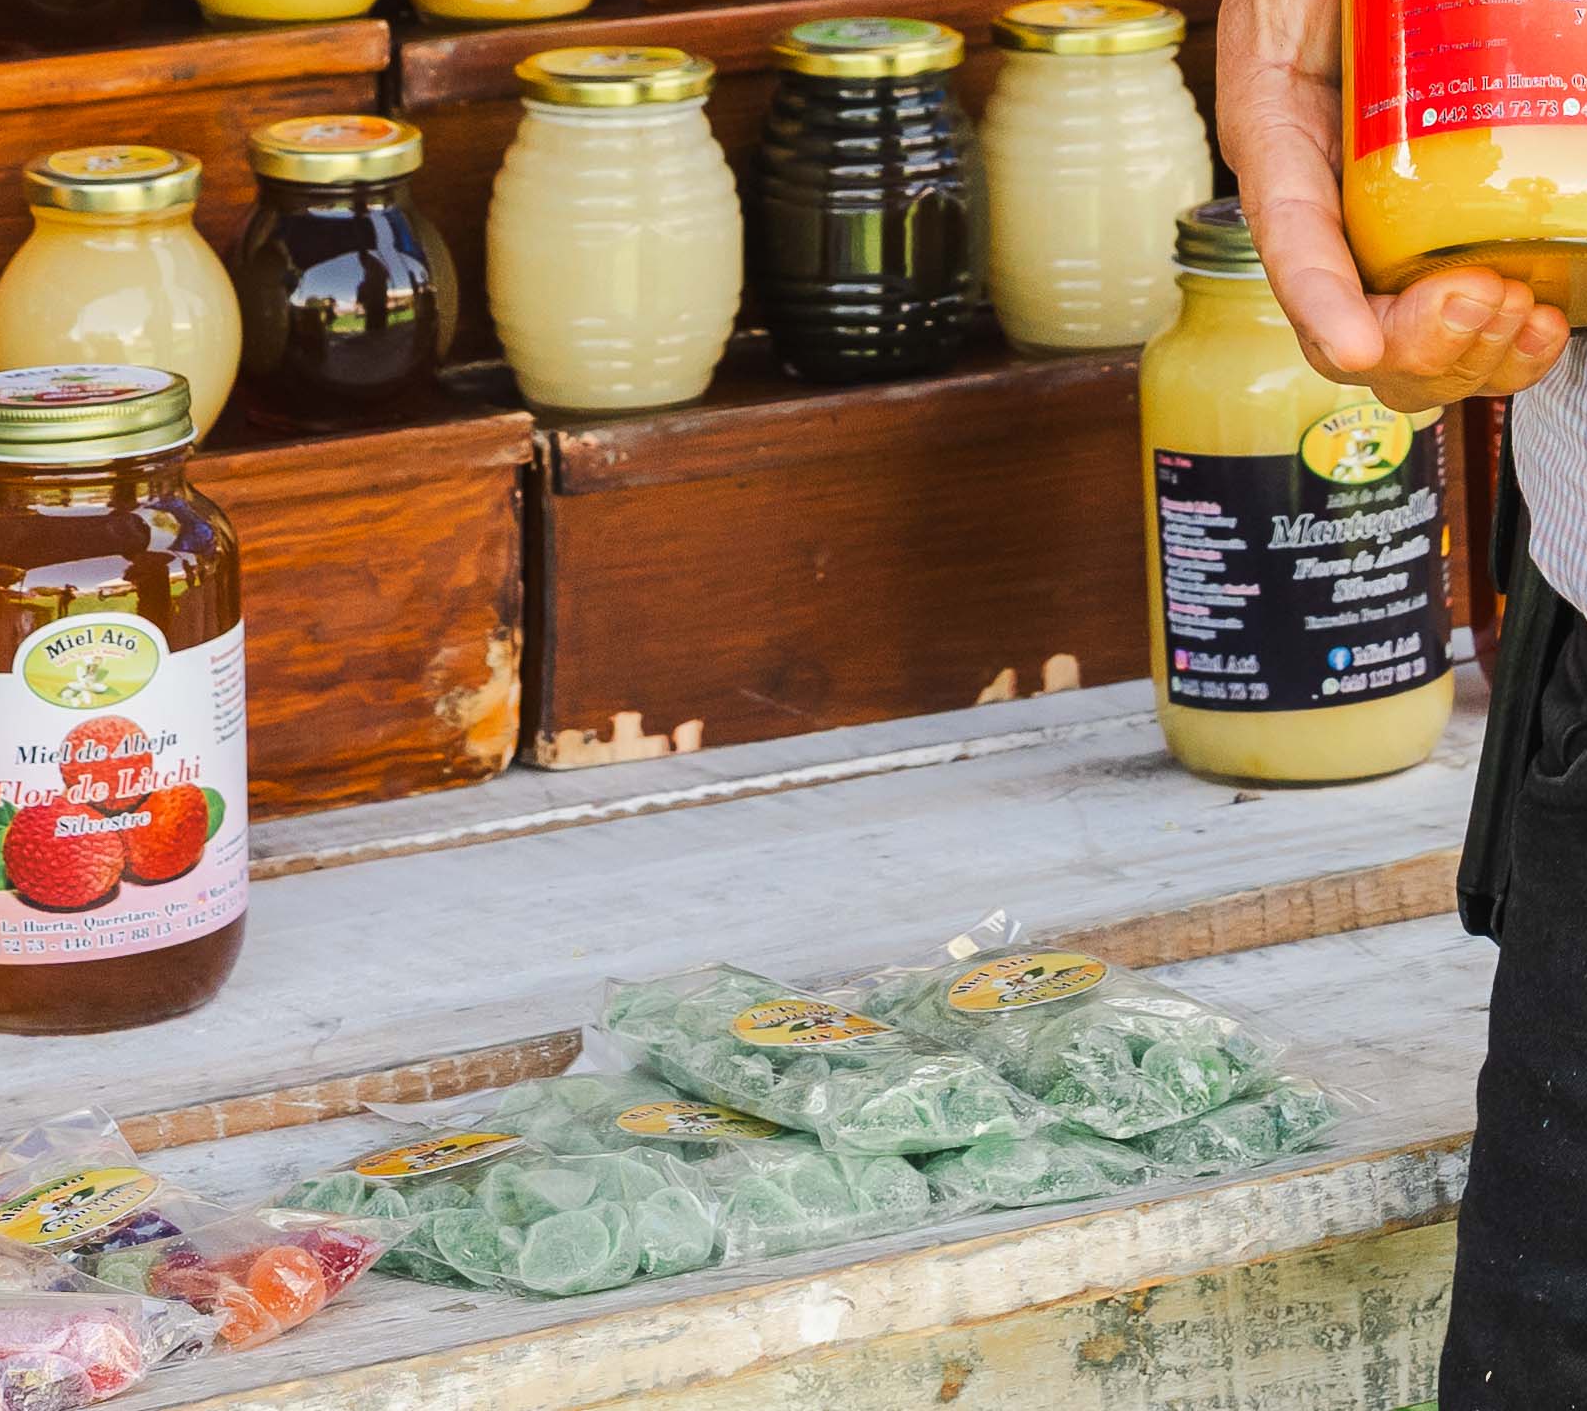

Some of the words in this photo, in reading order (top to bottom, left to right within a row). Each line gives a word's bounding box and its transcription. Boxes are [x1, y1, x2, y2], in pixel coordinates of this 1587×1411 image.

[1575, 8, 1587, 25] y
[1428, 83, 1445, 99] 22
[1448, 77, 1477, 96] Col.
[1482, 76, 1503, 92] La
[1507, 74, 1569, 90] Huerta,
[1438, 105, 1468, 124] 442
[1472, 101, 1505, 121] 334
[1509, 100, 1532, 118] 72
[1535, 99, 1559, 118] 73
[45, 629, 93, 660] Miel
[101, 629, 137, 651] Ató
[15, 744, 71, 766] Miel
[77, 740, 109, 757] de
[112, 730, 178, 758] Abeja
[66, 774, 110, 804] de
[116, 755, 202, 799] Litchi
[54, 811, 152, 838] Silvestre
